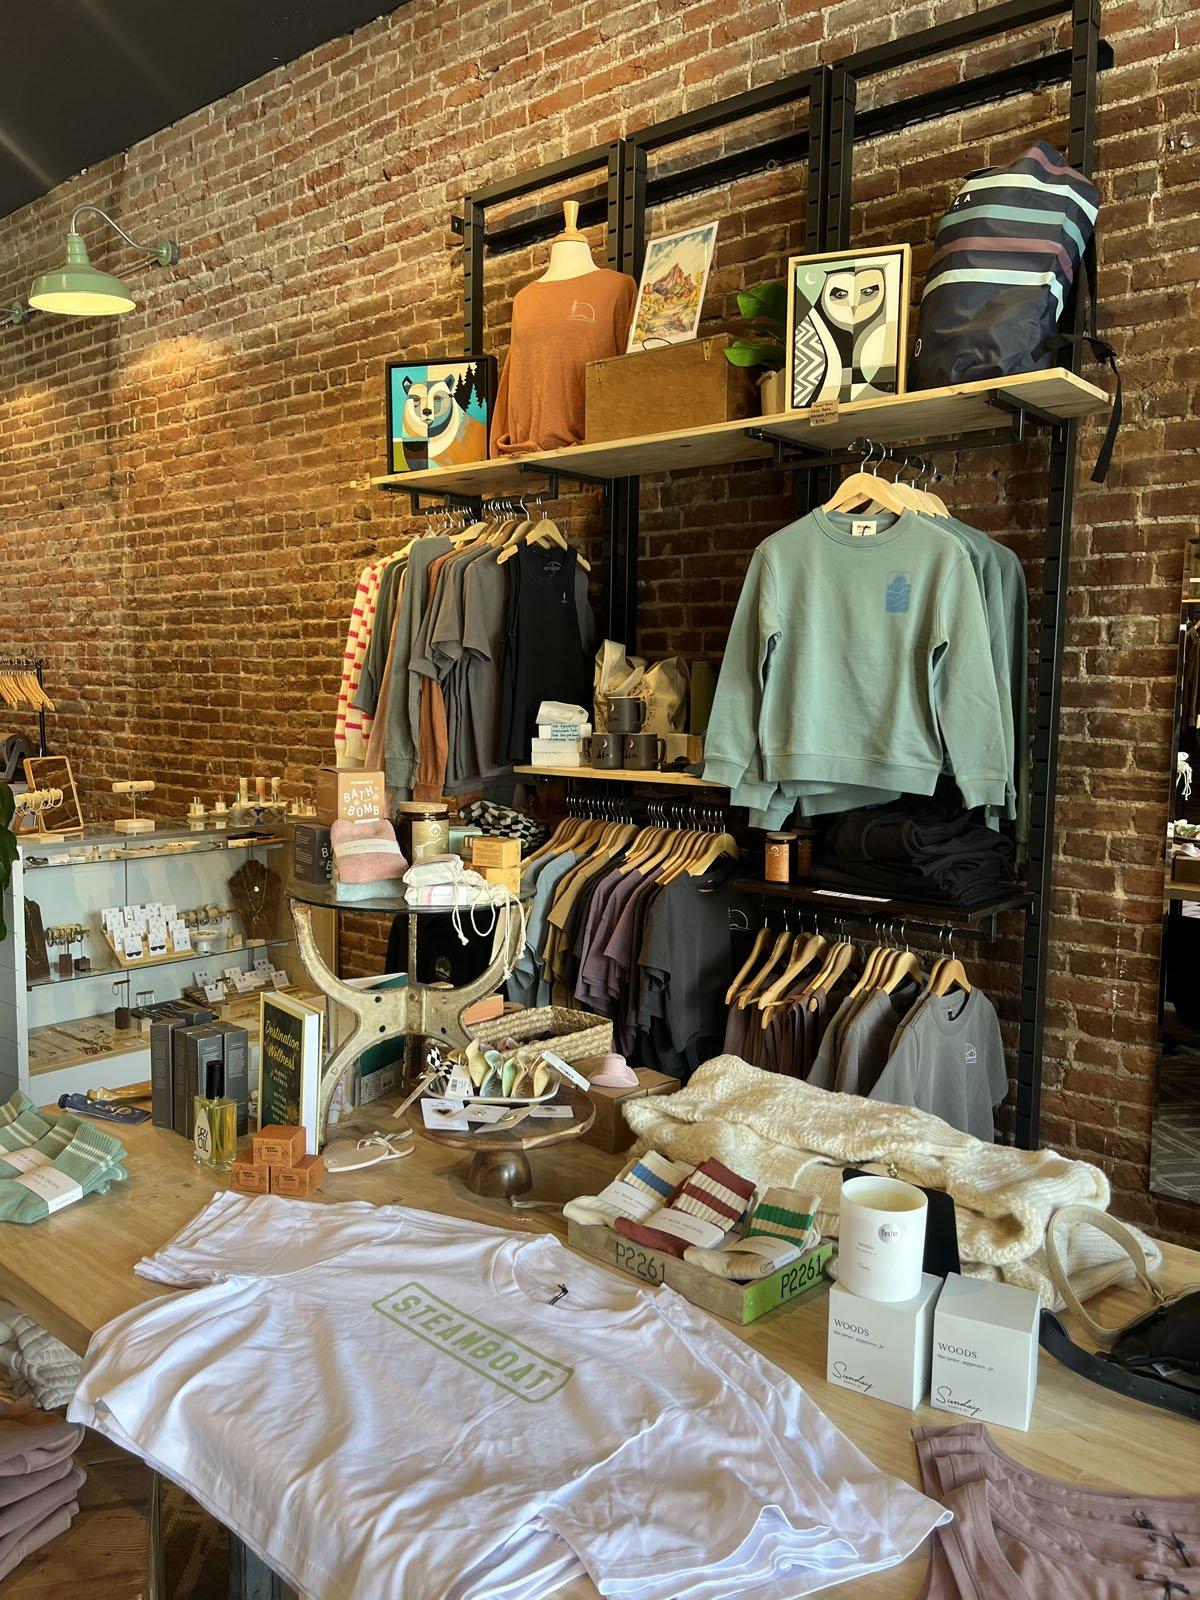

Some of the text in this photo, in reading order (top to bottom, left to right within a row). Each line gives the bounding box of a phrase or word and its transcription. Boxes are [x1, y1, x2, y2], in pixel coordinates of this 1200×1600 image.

[343, 785, 374, 803] BATH
[347, 803, 380, 818] BOMB
[265, 1020, 300, 1051] Destination
[268, 1043, 296, 1071] Wellness
[197, 1125, 209, 1140] DRY
[197, 1137, 209, 1153] OIL
[615, 1241, 666, 1282] P2261
[780, 1254, 823, 1299] P2261
[833, 1318, 870, 1337] WOODS
[391, 1295, 555, 1390] STEAMBOAT
[937, 1342, 978, 1359] WOODS
[832, 1361, 873, 1393] Sunday
[935, 1385, 982, 1417] Sunday
